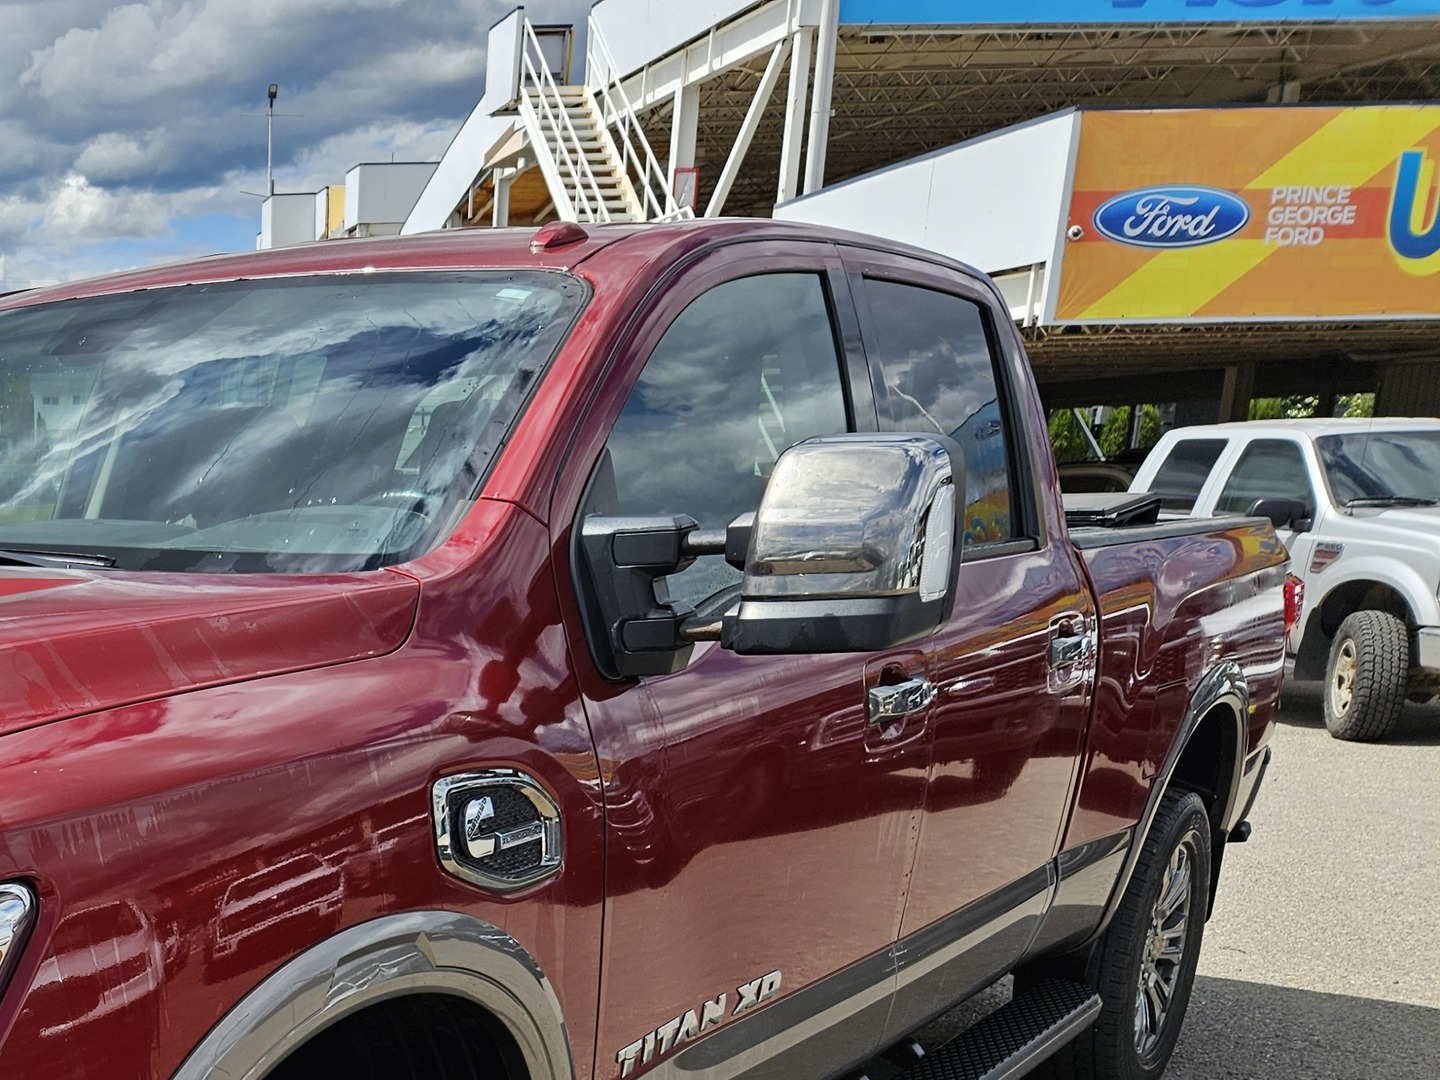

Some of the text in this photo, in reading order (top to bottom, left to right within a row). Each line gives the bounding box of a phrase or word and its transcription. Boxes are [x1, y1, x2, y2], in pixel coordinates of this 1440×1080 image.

[1271, 185, 1353, 205] PRINCE
[1123, 194, 1221, 239] Ford
[1267, 205, 1358, 226] GEORGE
[1264, 226, 1325, 247] FORD
[617, 968, 783, 1079] TITAN XD
